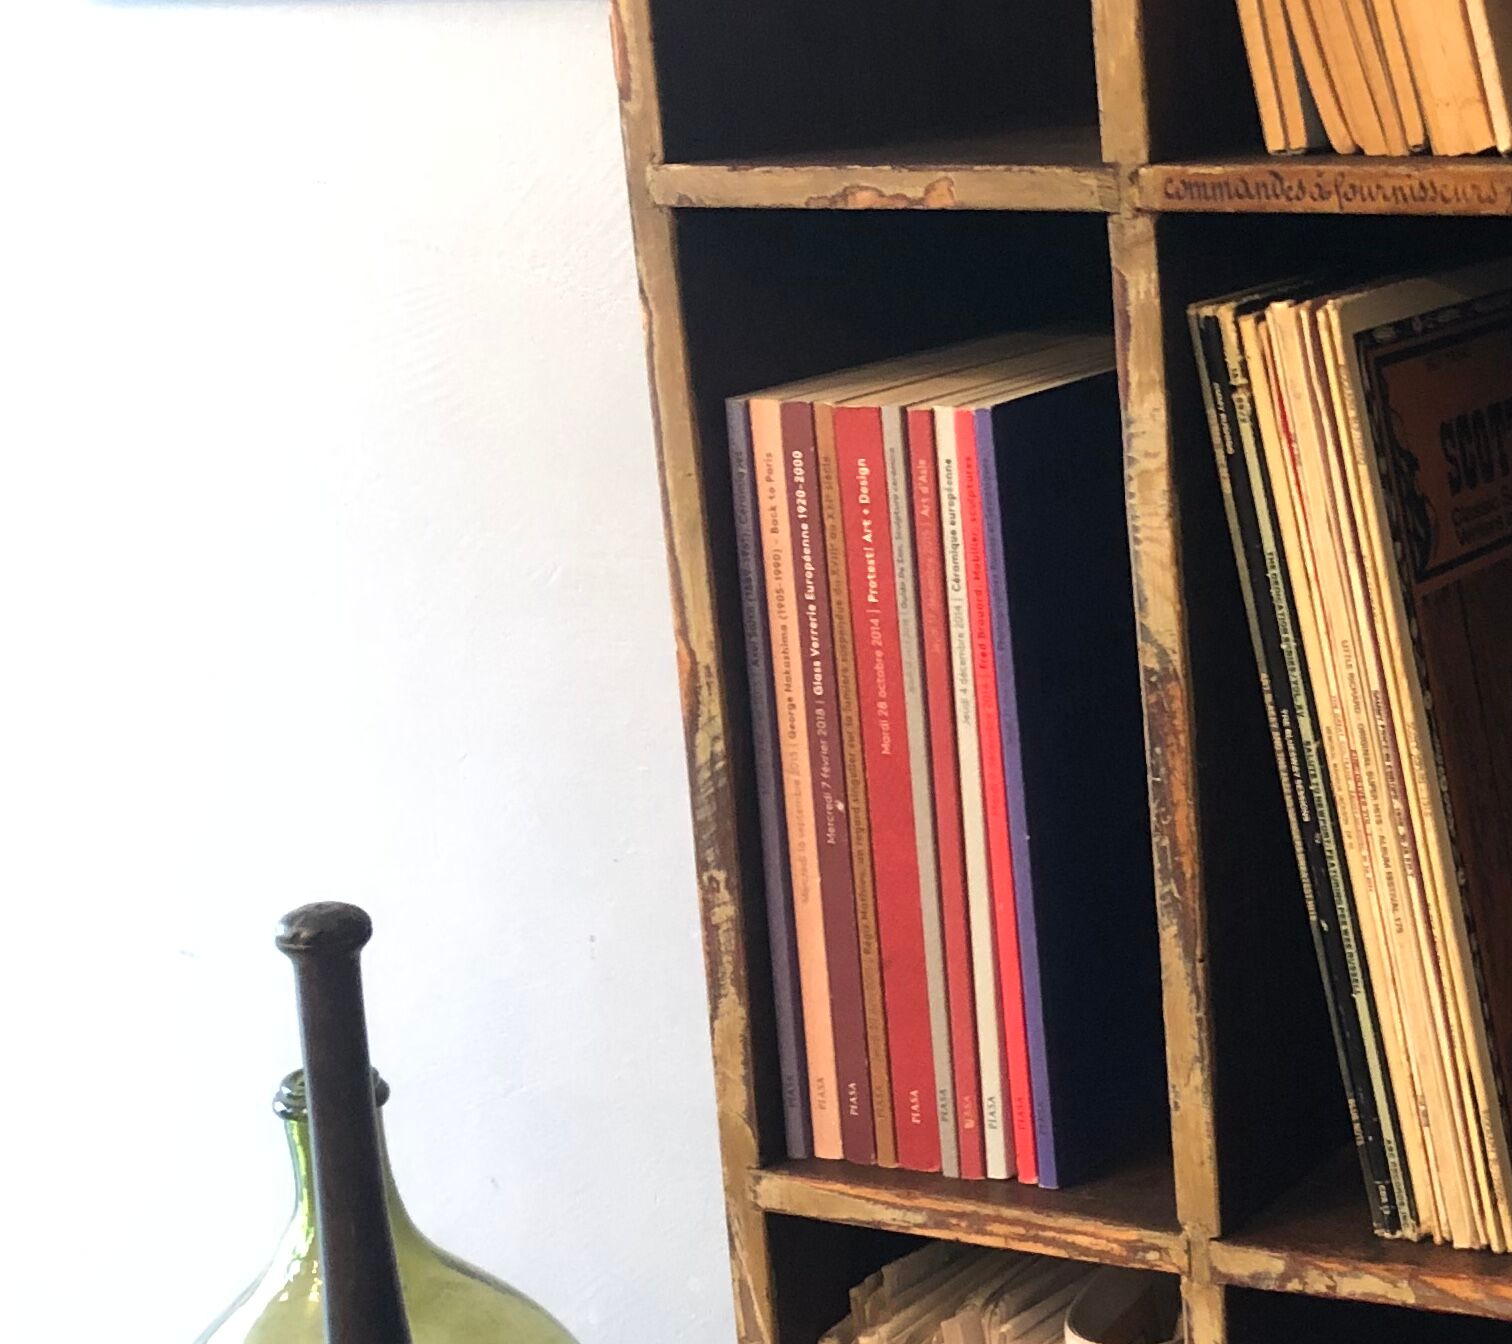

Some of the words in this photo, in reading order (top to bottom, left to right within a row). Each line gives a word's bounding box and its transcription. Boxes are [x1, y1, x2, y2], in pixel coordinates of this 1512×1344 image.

[763, 452, 774, 481] Paris
[855, 457, 872, 504] Design
[766, 486, 776, 500] to
[791, 450, 808, 519] 1920-2000
[942, 458, 958, 526] européenne
[767, 505, 779, 534] Back
[919, 496, 929, 516] Art
[860, 519, 873, 543] Art
[798, 523, 817, 600] Européenne
[947, 529, 963, 592] Céramique
[1265, 551, 1276, 569] THE
[772, 548, 787, 619] (1905-1990)
[952, 605, 964, 629] 2014
[1269, 572, 1289, 635] DEDICATION
[805, 603, 820, 656] Verrerie
[869, 618, 882, 647] 2014
[778, 624, 793, 692] Nakashima
[954, 632, 968, 684] décembre
[1340, 639, 1353, 668] LITTLE
[810, 660, 823, 696] Glass
[872, 650, 887, 698] octobre
[877, 700, 888, 716] 28
[1347, 671, 1362, 714] RICHARD
[784, 696, 797, 738] George
[815, 708, 827, 736] 2018
[960, 697, 972, 724] Jeudi
[879, 719, 891, 754] Mardi
[1356, 722, 1371, 766] ORIGINAL
[818, 739, 830, 778] février
[1365, 770, 1378, 800] SUPER
[822, 791, 836, 844] Mercredi
[1372, 803, 1383, 825] HITS
[1377, 834, 1391, 868] ALBUM
[1384, 870, 1399, 913] FESTIVAL
[816, 1077, 826, 1110] PIASA
[847, 1081, 858, 1115] PIASA
[909, 1089, 920, 1124] PIASA
[939, 1088, 949, 1122] PIASA
[962, 1095, 973, 1128] ASA
[986, 1096, 997, 1130] PIASA
[1015, 1096, 1025, 1130] PIASA
